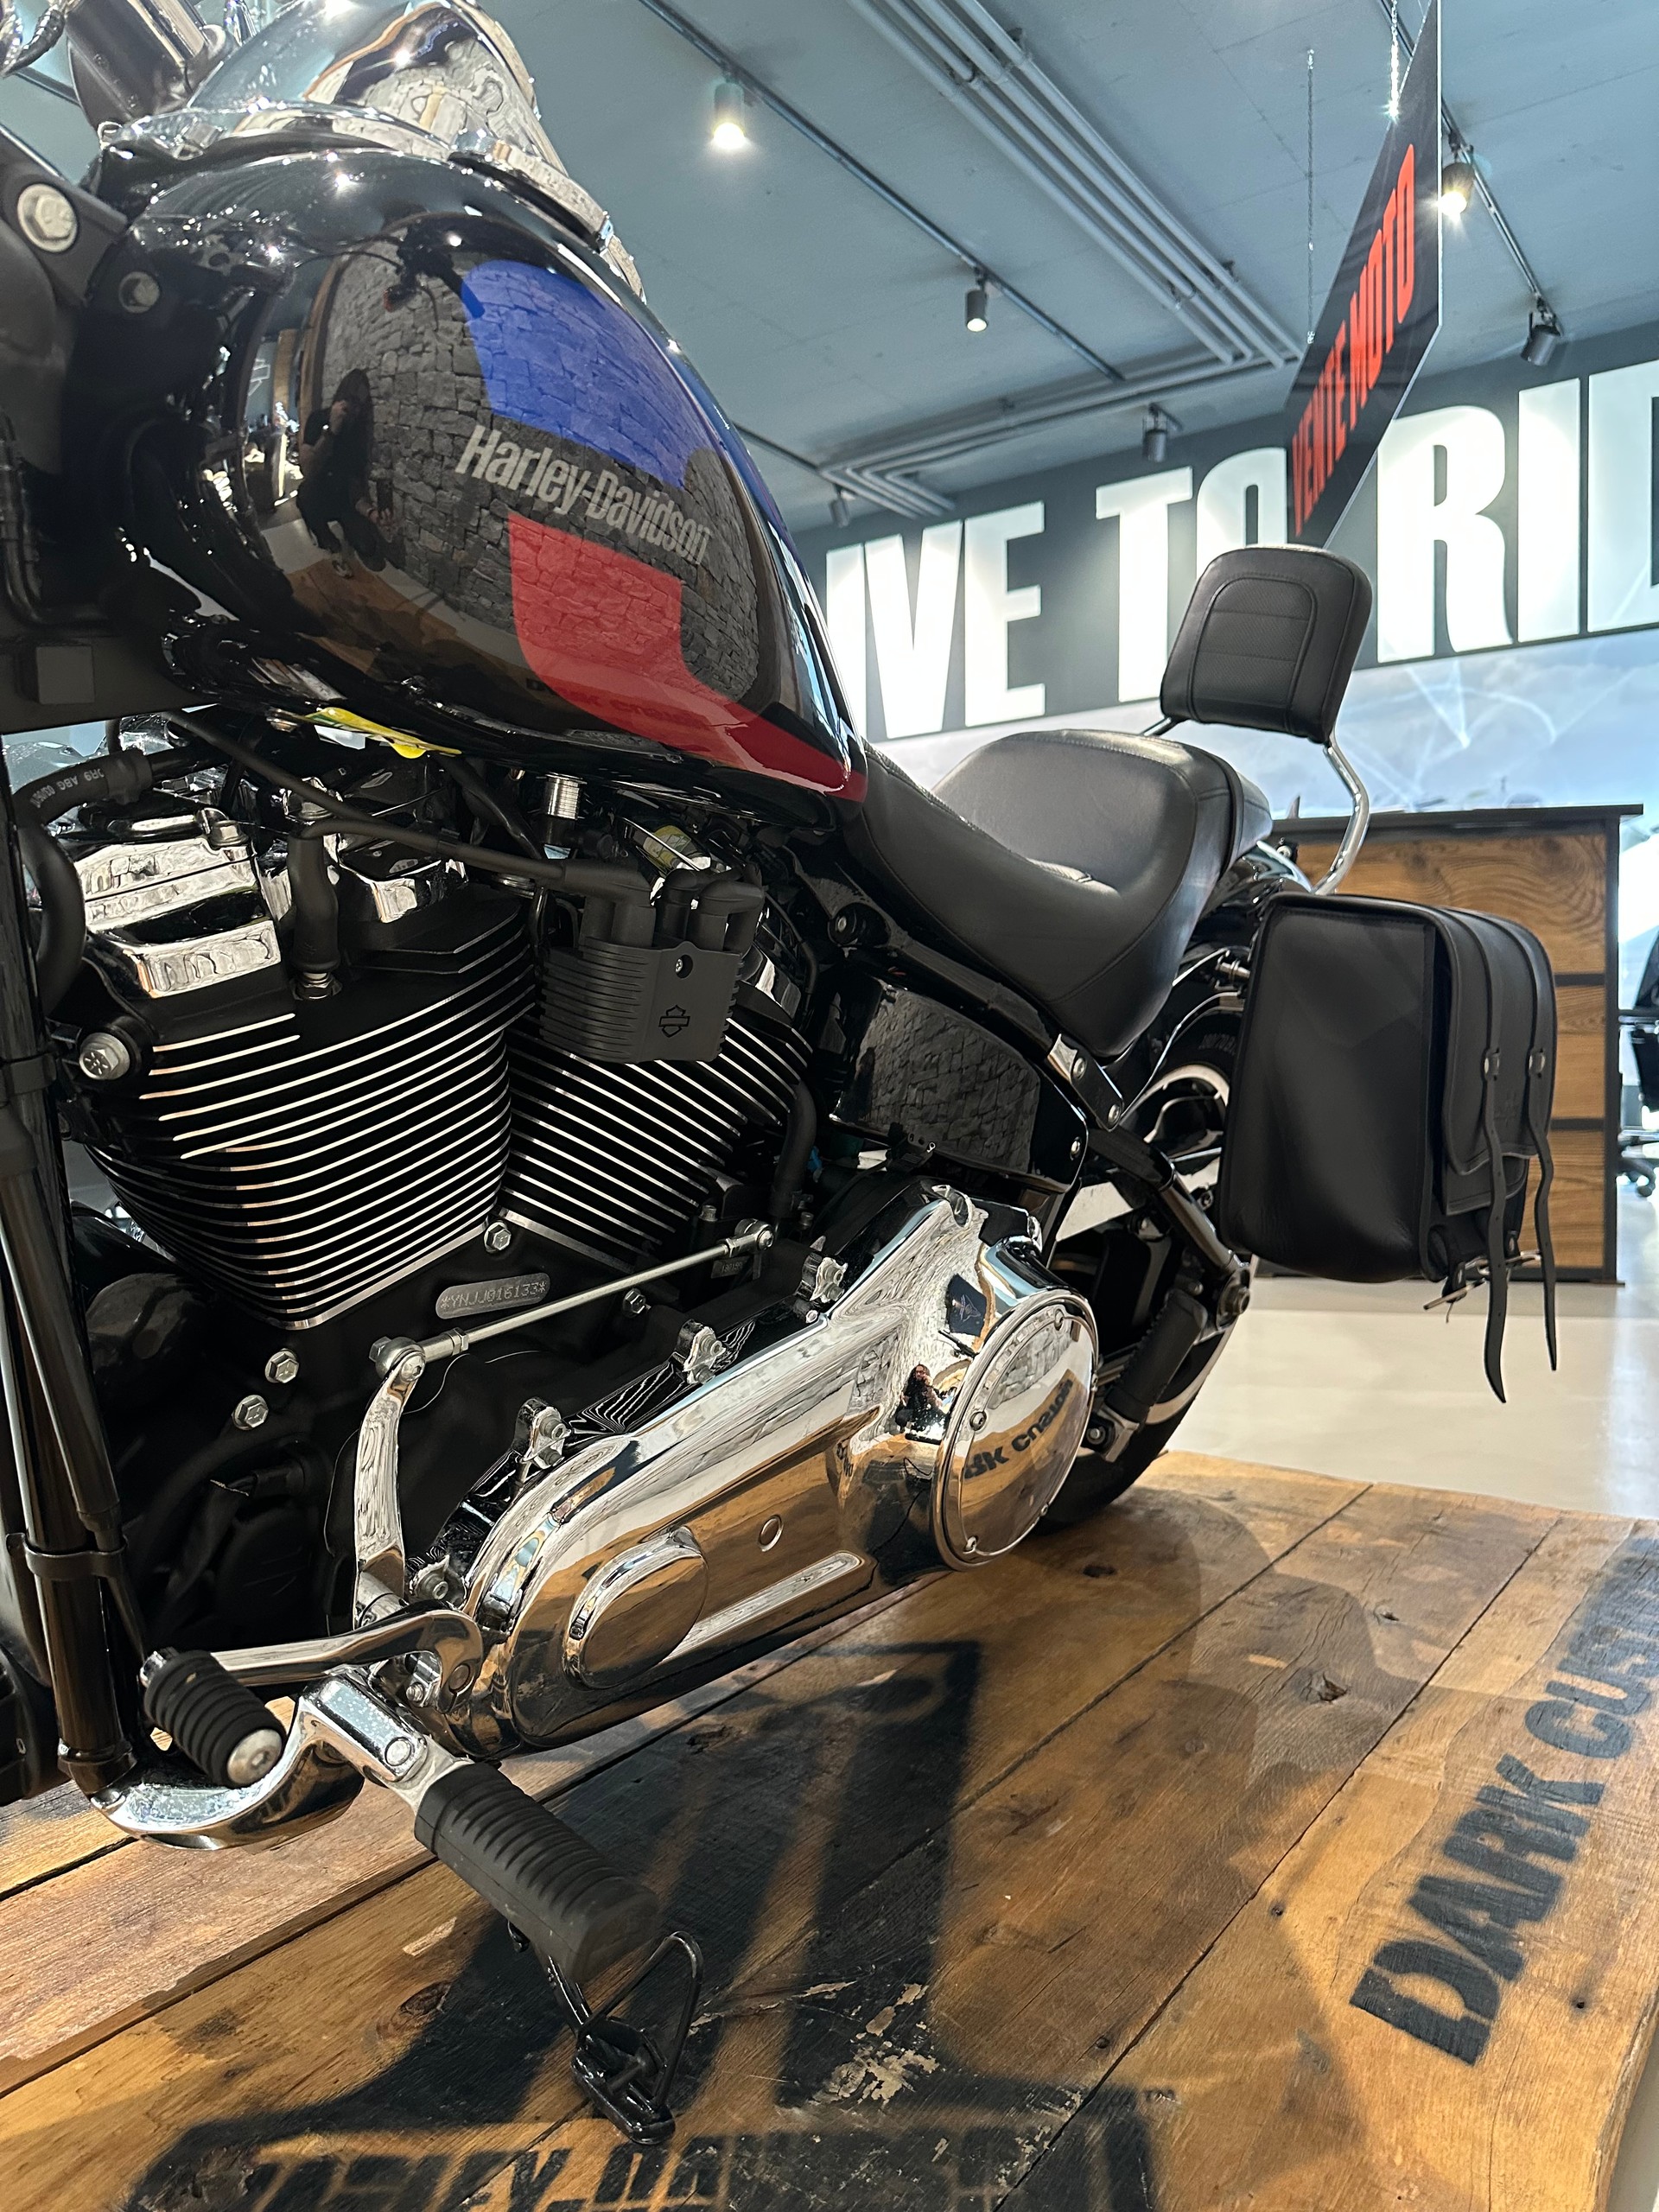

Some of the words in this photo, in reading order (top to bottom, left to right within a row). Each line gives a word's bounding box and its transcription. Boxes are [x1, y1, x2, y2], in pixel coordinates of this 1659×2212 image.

[1292, 320, 1347, 537] VENTE
[1350, 143, 1414, 431] MOTO
[454, 424, 713, 566] Harley-Davidson
[826, 499, 1046, 744] IVE
[1349, 1753, 1605, 2066] DARK
